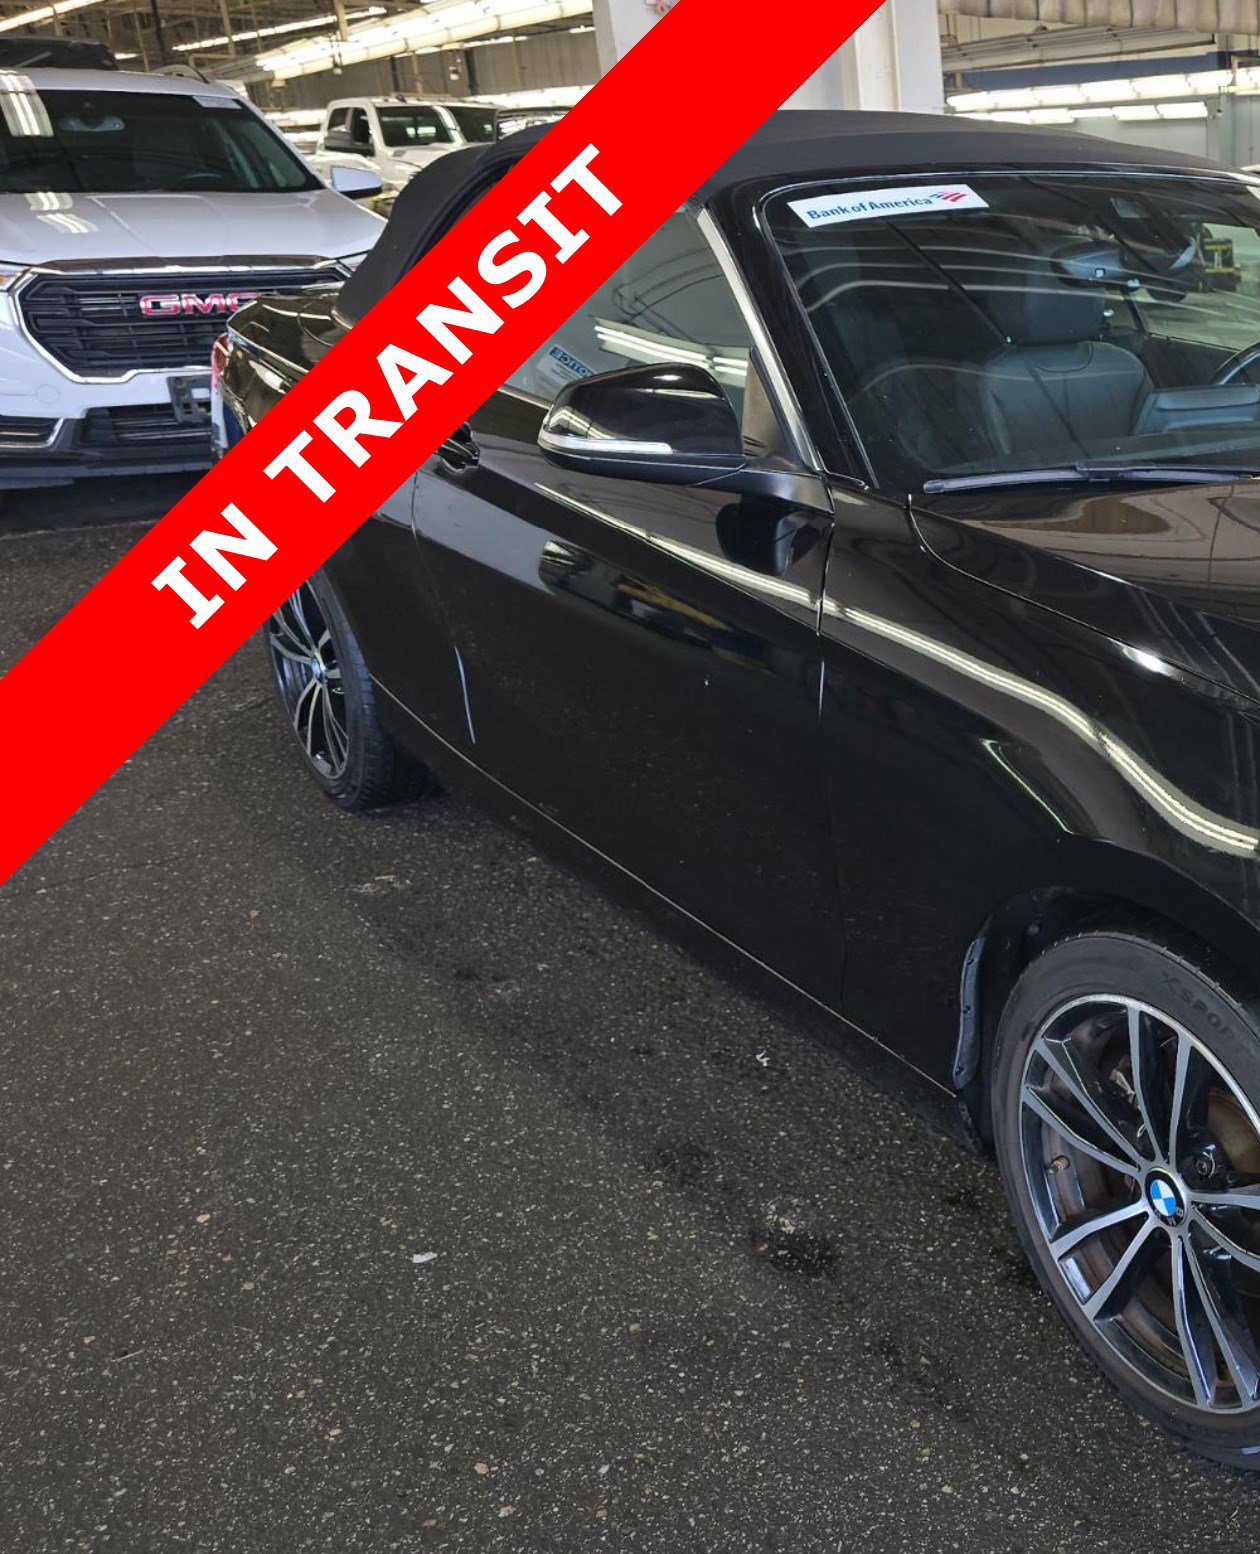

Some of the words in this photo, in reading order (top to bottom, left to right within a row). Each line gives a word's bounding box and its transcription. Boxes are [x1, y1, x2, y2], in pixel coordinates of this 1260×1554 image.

[807, 203, 849, 219] Bank
[851, 201, 869, 213] of
[870, 197, 934, 211] America
